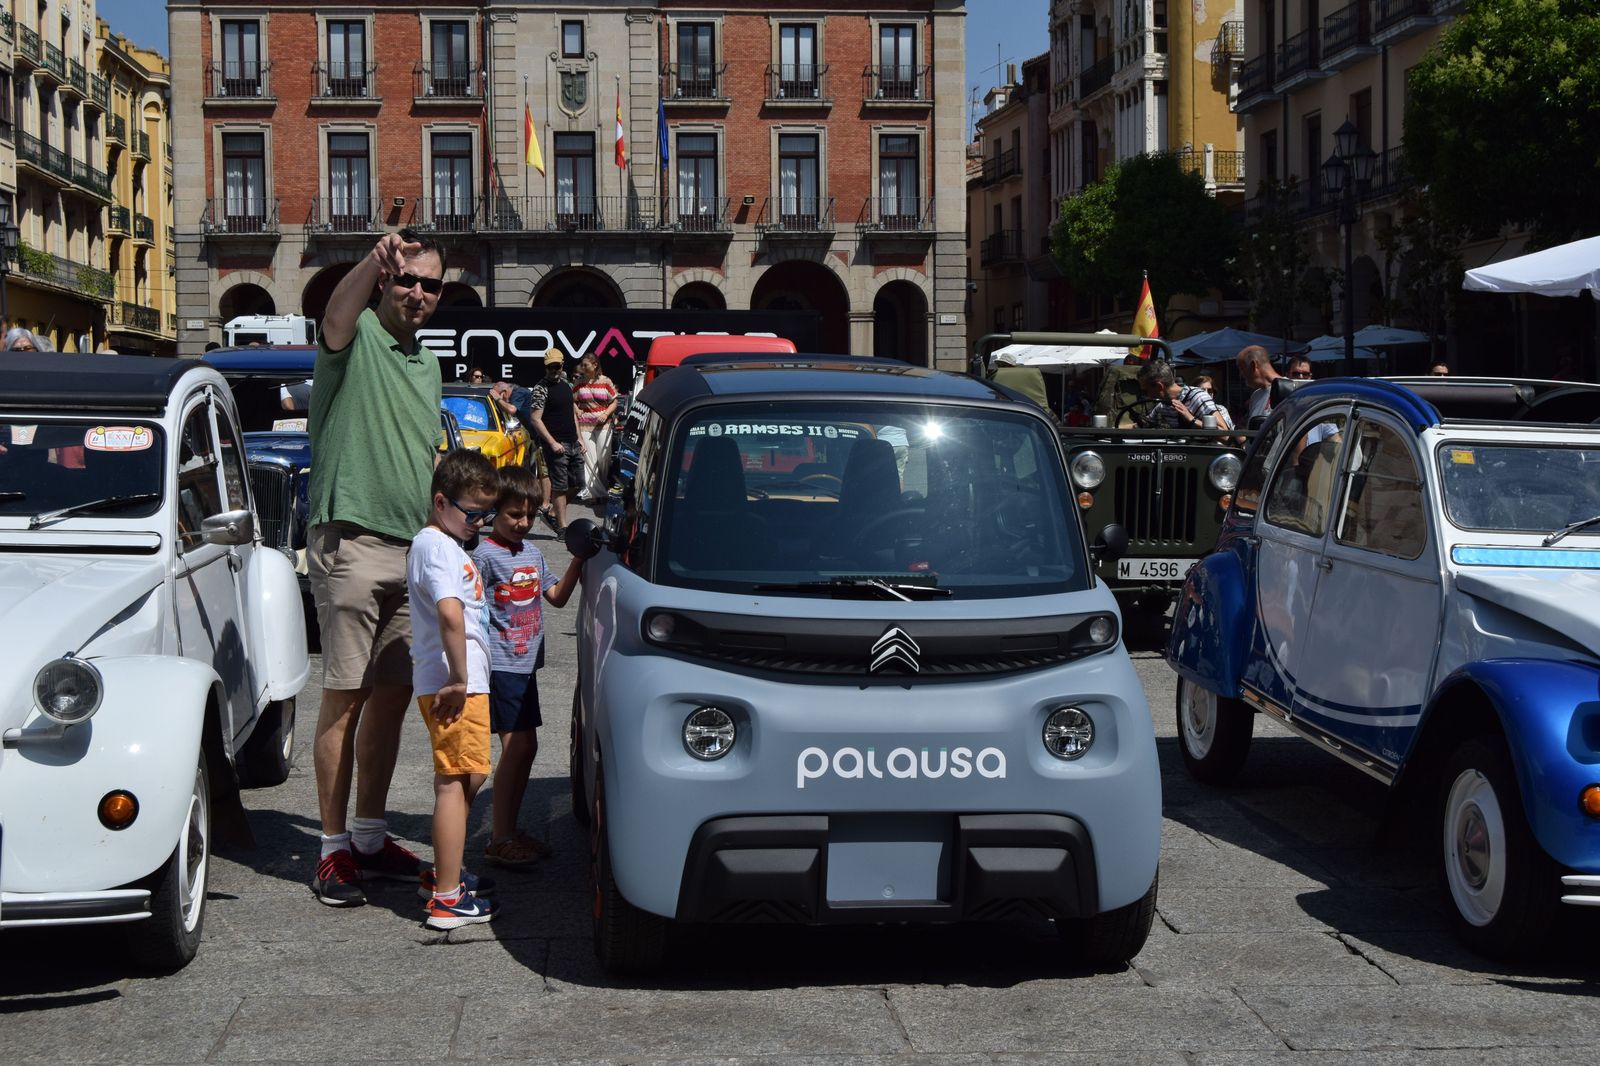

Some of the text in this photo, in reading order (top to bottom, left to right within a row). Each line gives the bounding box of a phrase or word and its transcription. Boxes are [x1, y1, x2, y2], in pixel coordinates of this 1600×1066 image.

[724, 424, 823, 436] RAMSES II
[1131, 453, 1151, 462] Jeep
[1120, 562, 1130, 577] M
[1140, 562, 1179, 577] 4596
[797, 746, 1007, 789] palausa
